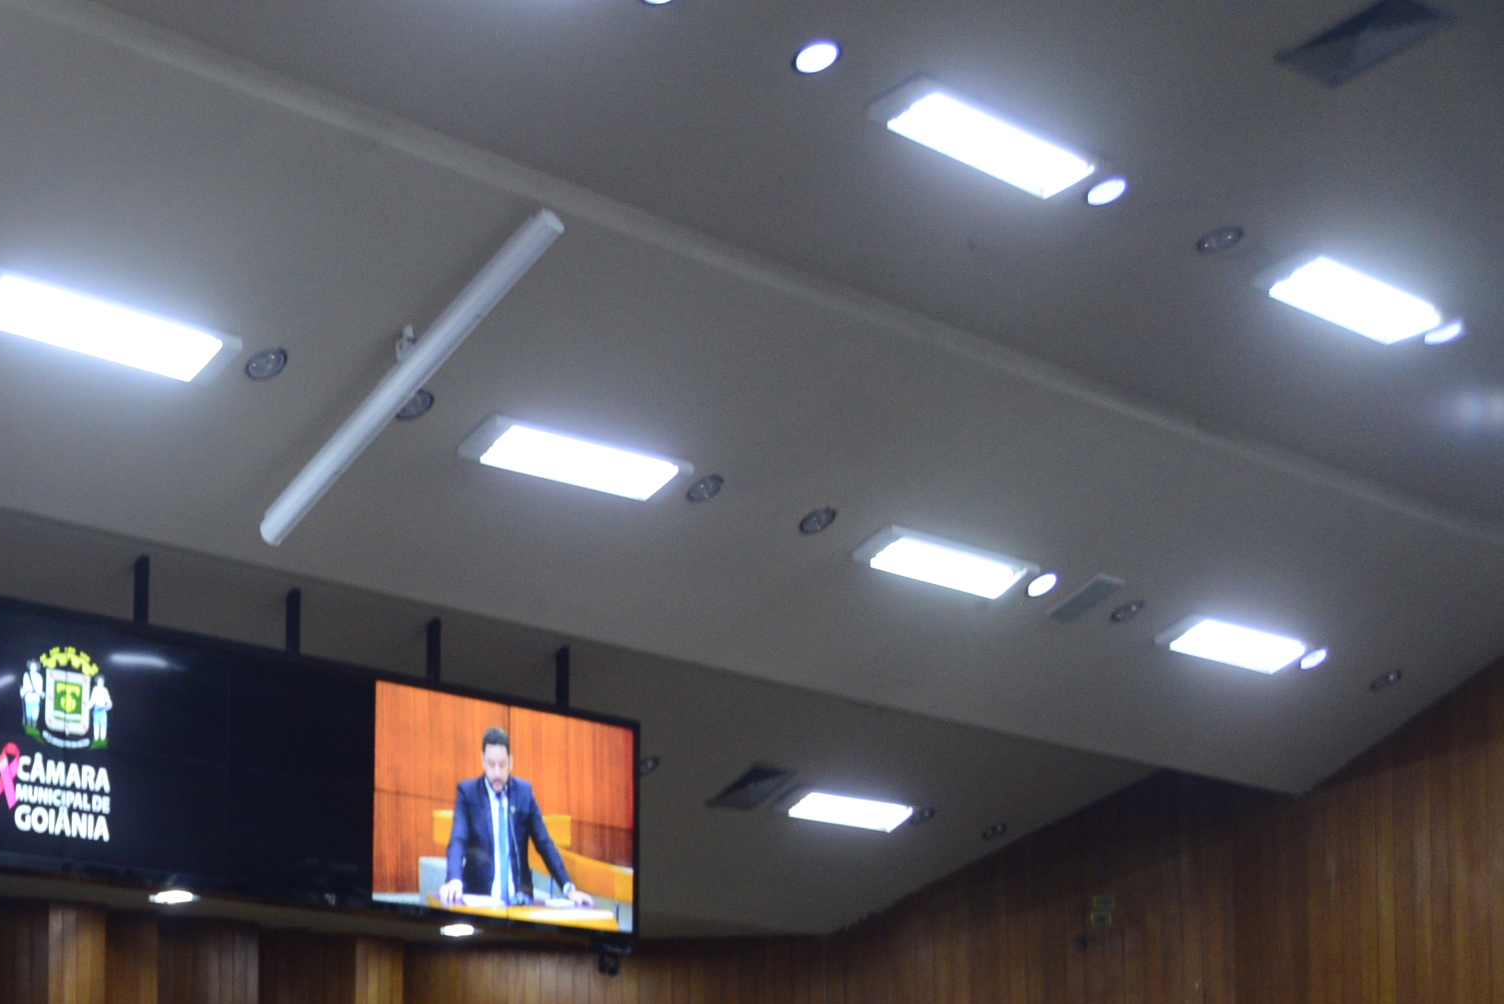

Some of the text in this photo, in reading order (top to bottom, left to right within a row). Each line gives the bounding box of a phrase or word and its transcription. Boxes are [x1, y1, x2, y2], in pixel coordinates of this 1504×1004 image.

[17, 752, 111, 794] CÂMARA
[15, 783, 111, 815] MUNICIPAL DE
[14, 804, 110, 842] GOIÂNIA
